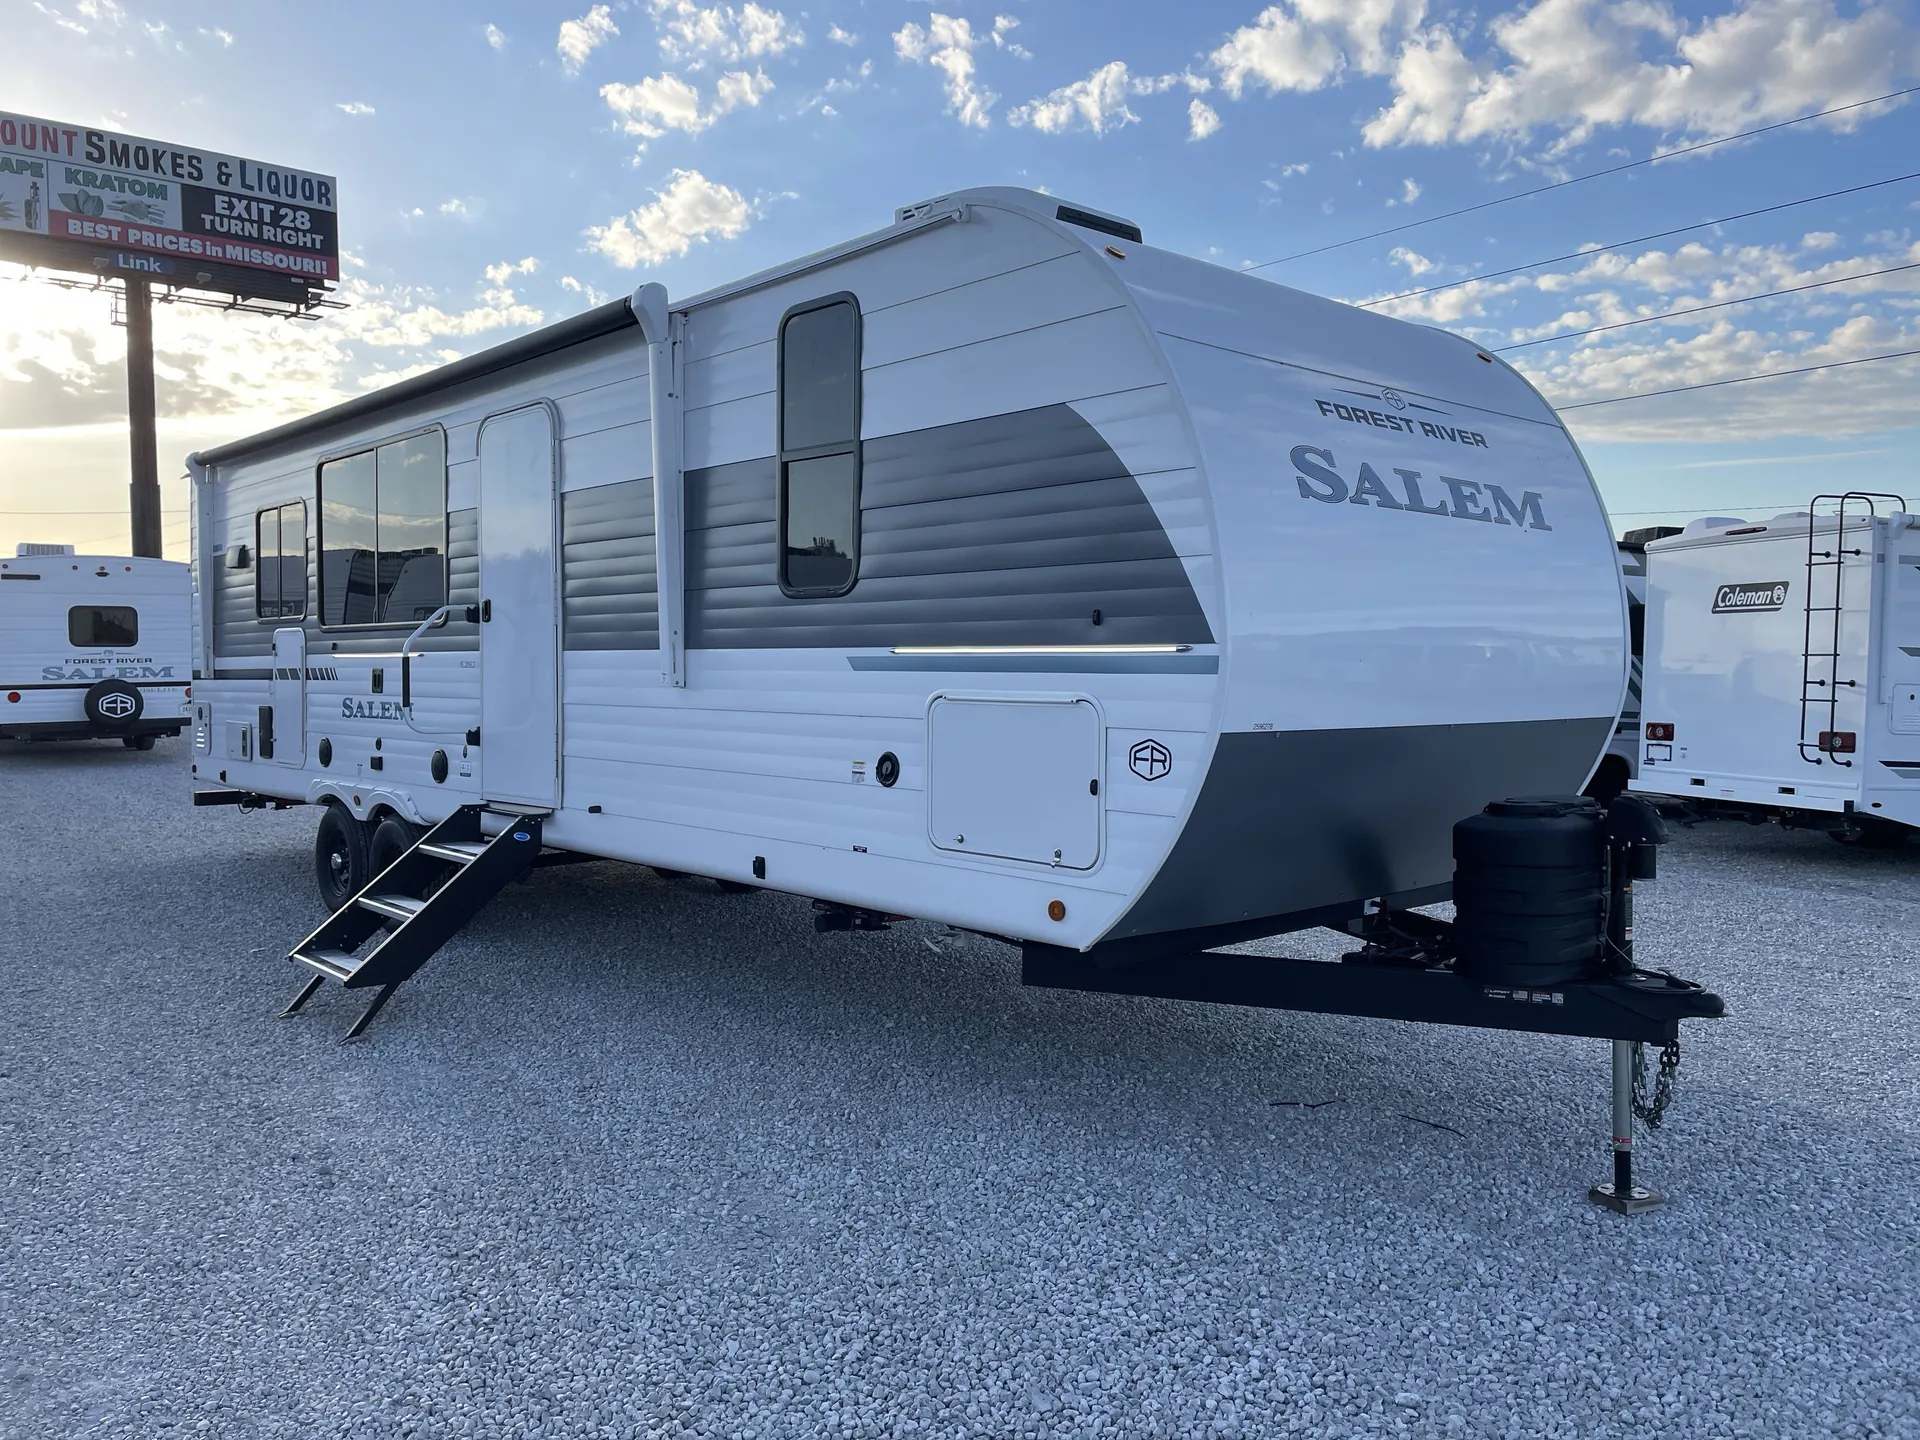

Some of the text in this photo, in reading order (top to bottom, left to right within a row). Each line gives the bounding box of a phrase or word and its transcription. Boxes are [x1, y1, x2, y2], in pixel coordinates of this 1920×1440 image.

[65, 167, 168, 200] KRATOM
[85, 130, 203, 182] SMOKES
[216, 161, 233, 186] &
[239, 160, 332, 207] LIQUOR
[214, 194, 311, 230] EXIT 28
[67, 218, 328, 275] BEST PRICES in MISSOURI!
[201, 213, 324, 249] TURN RIGHT
[118, 253, 161, 273] Link
[1314, 399, 1489, 449] FOREST RIVER
[1289, 444, 1553, 532] SALEM
[1717, 586, 1772, 607] Coleman
[42, 666, 175, 681] SALEM
